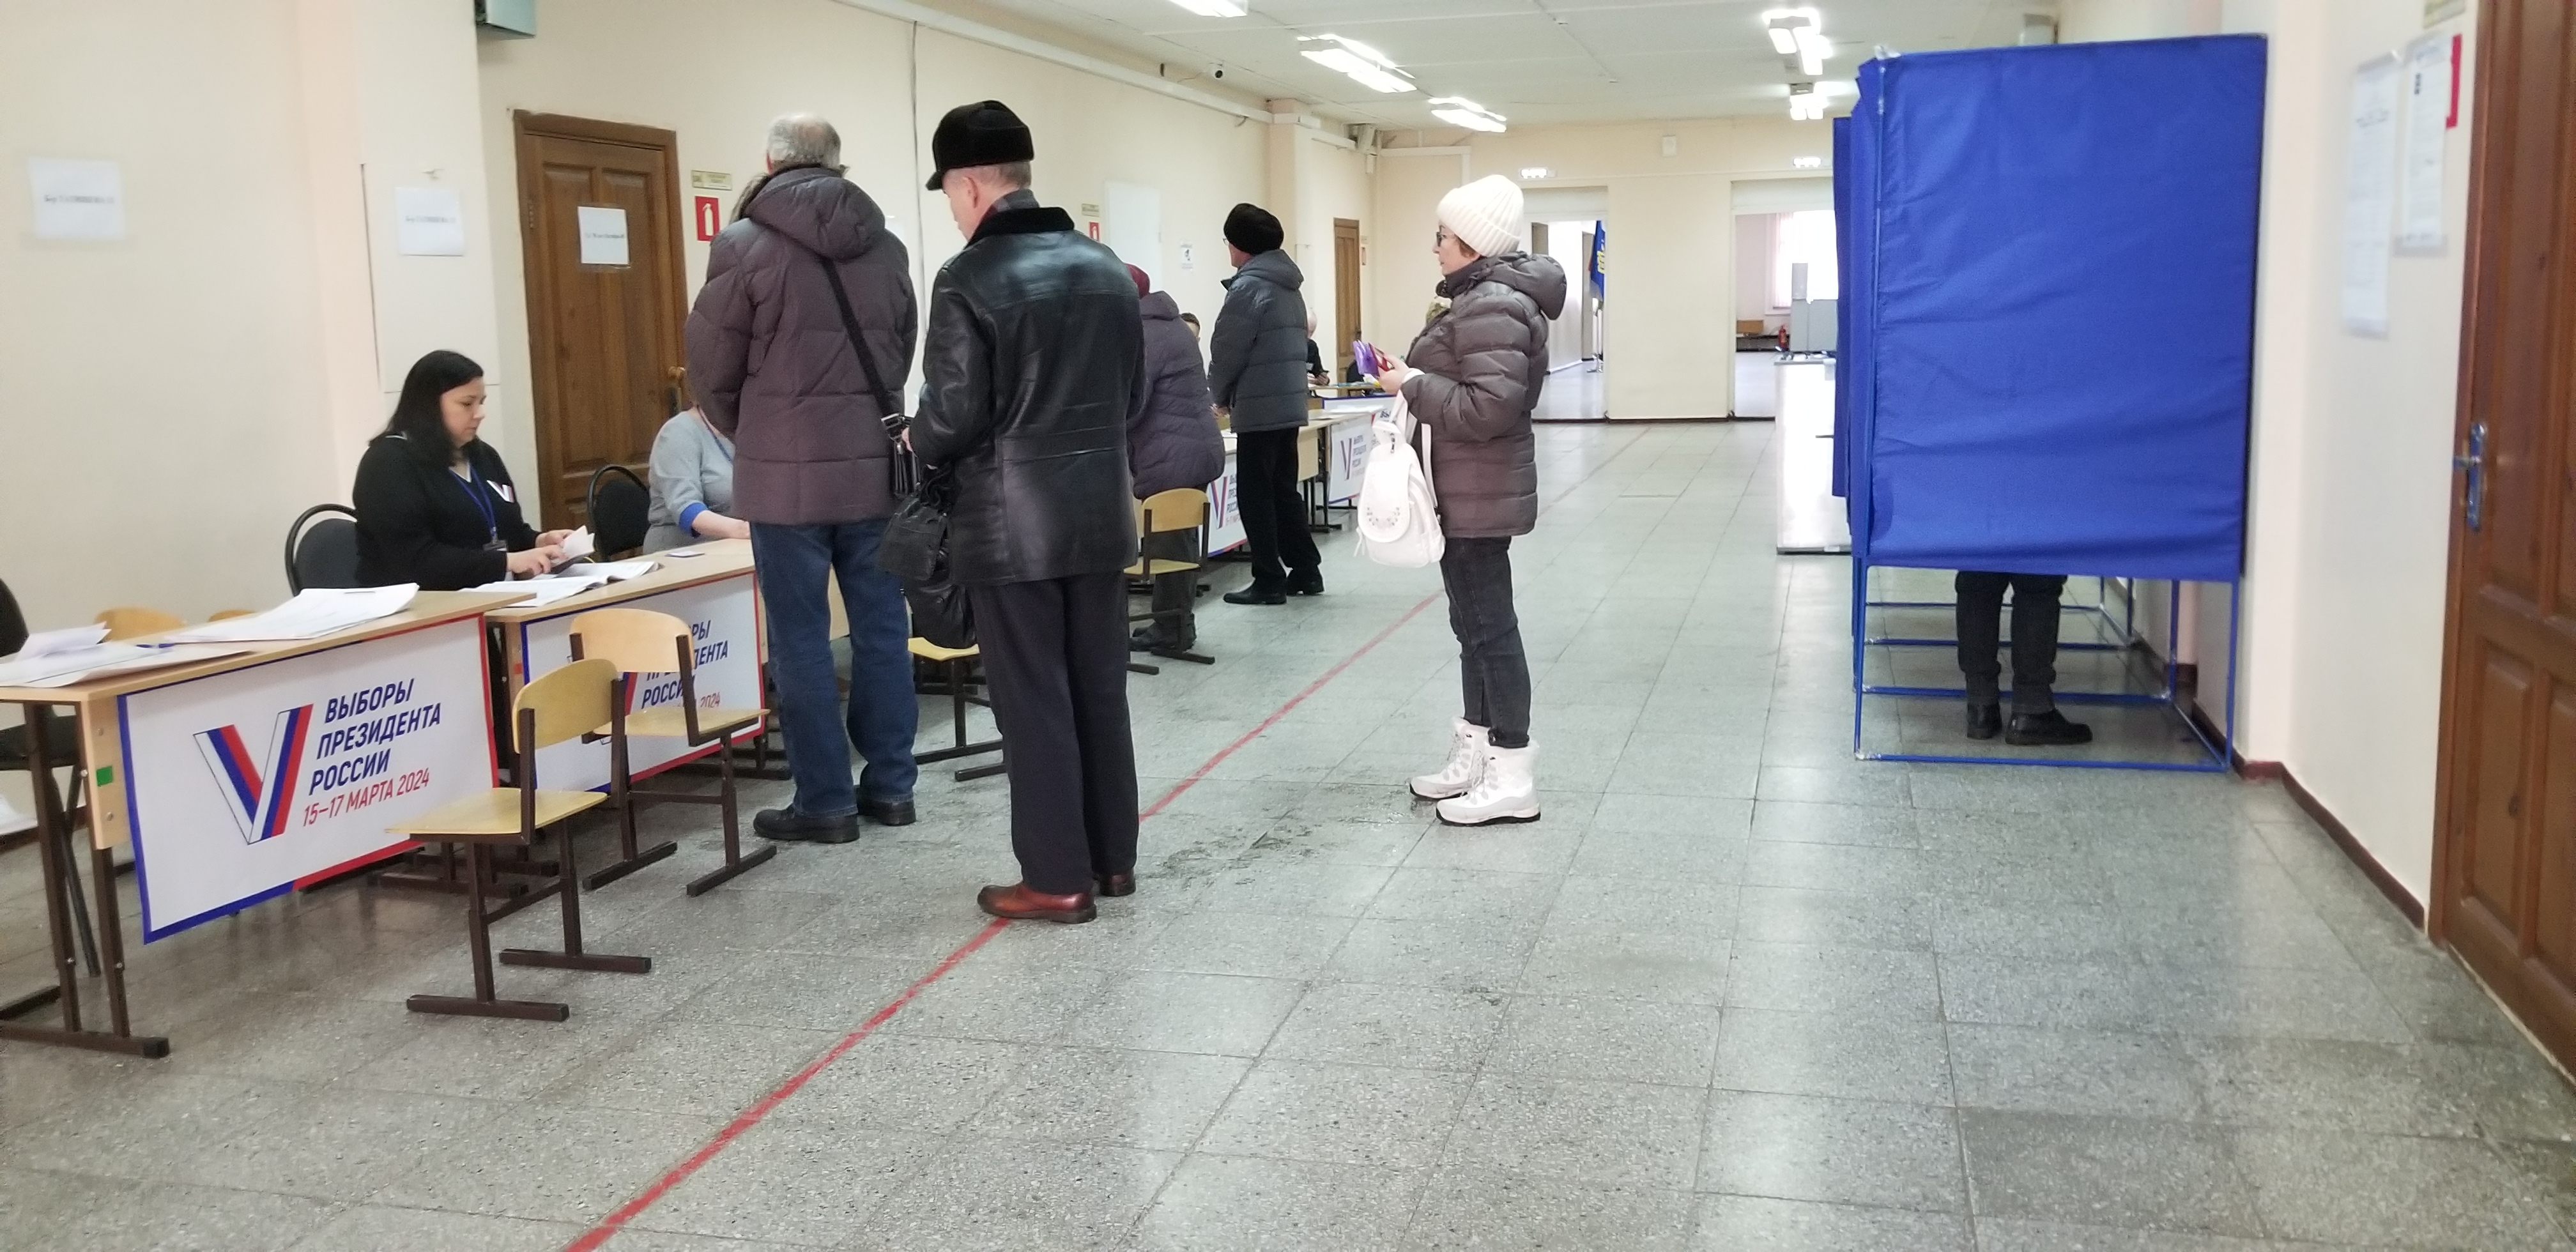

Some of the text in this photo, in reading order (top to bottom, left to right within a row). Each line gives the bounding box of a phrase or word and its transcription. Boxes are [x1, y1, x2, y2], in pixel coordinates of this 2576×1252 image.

[324, 678, 415, 724] ВЫБОРЫ
[316, 703, 441, 760] ПРЕЗИДЕНТА
[309, 748, 391, 796] РОССИИ
[346, 778, 394, 813] МАРТА
[396, 767, 430, 797] 2024
